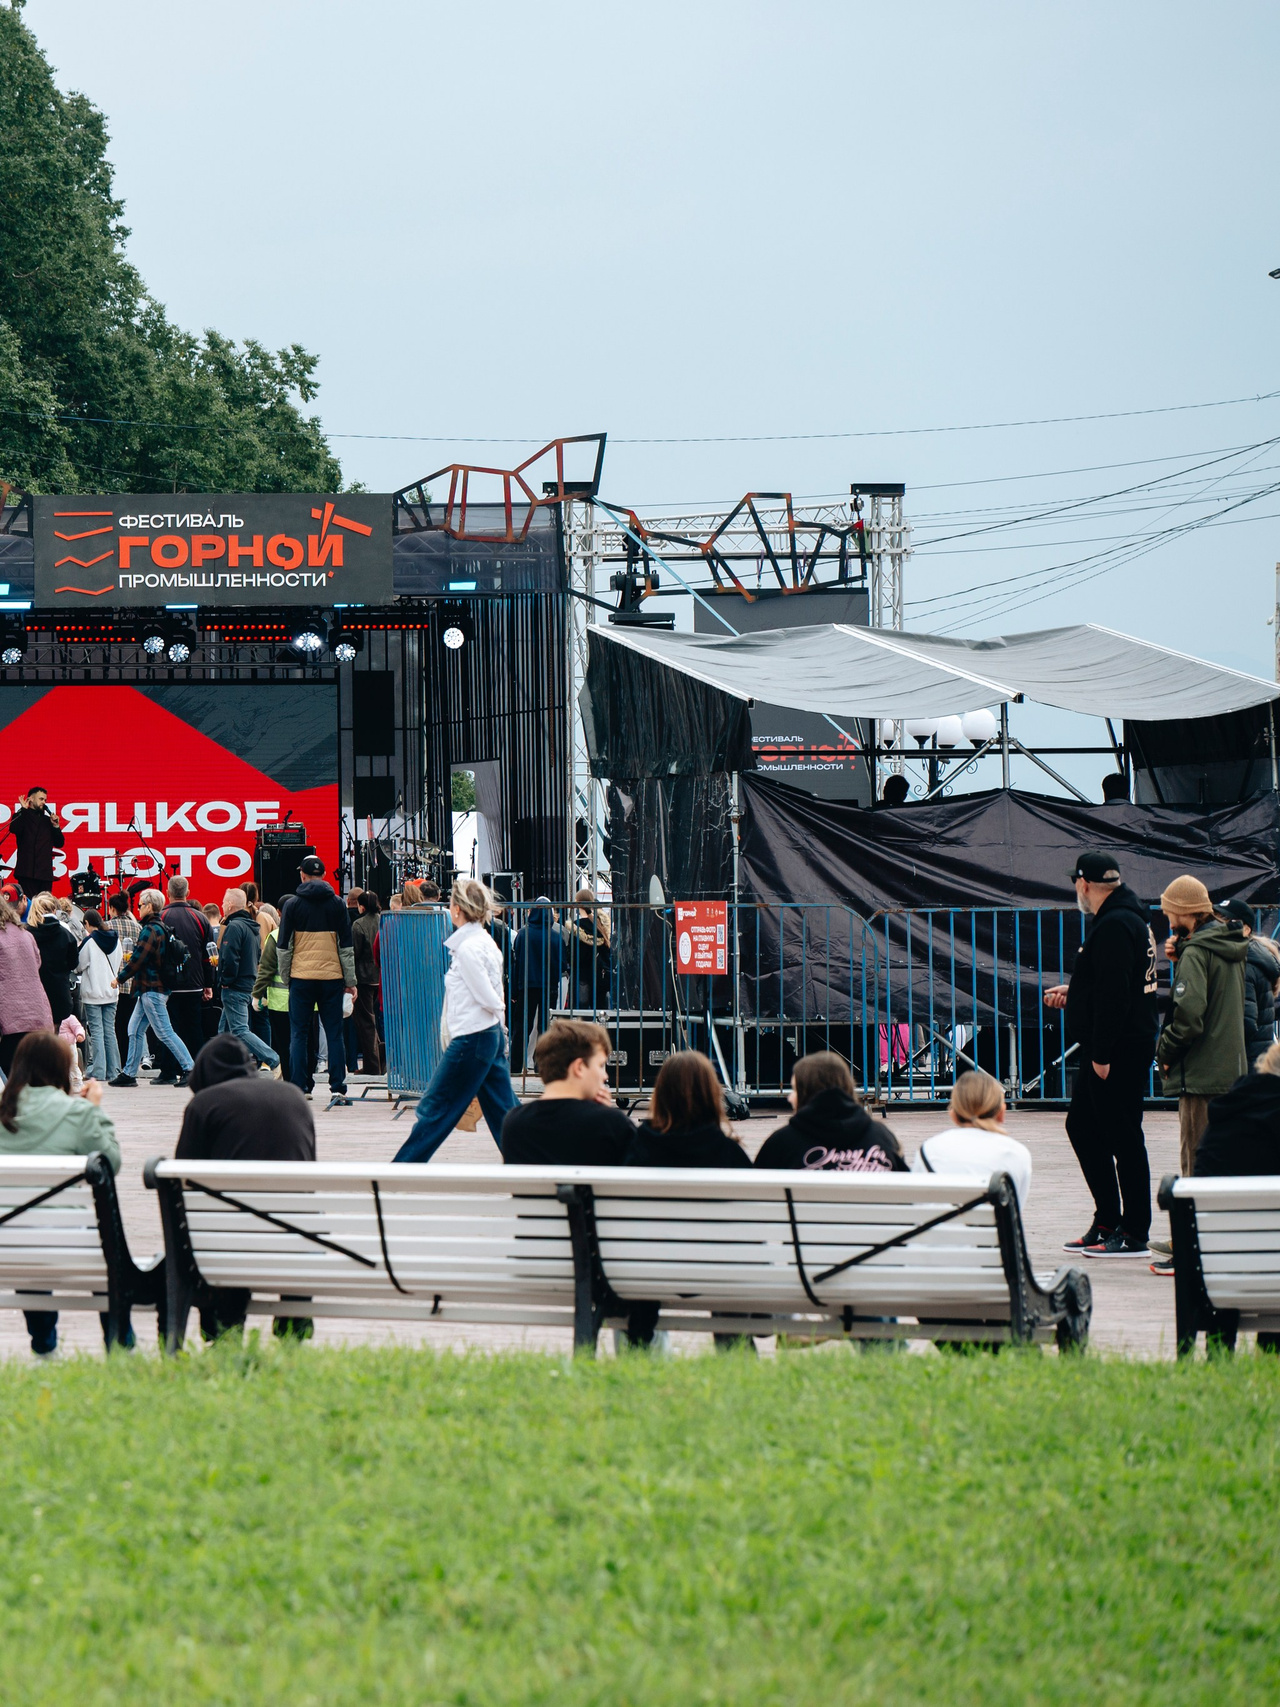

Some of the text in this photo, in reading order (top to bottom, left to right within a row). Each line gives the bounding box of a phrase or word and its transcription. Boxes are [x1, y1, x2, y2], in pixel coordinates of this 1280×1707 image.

[118, 513, 244, 529] ФЕСТИВАЛЬ
[118, 506, 344, 570] ГОРНОЙ
[118, 572, 326, 589] ПРОМЫШЛЕННОСТИ
[752, 735, 804, 743] ЕСТИВАЛЬ
[756, 763, 844, 771] ОМЫШЛЕННОСТИ
